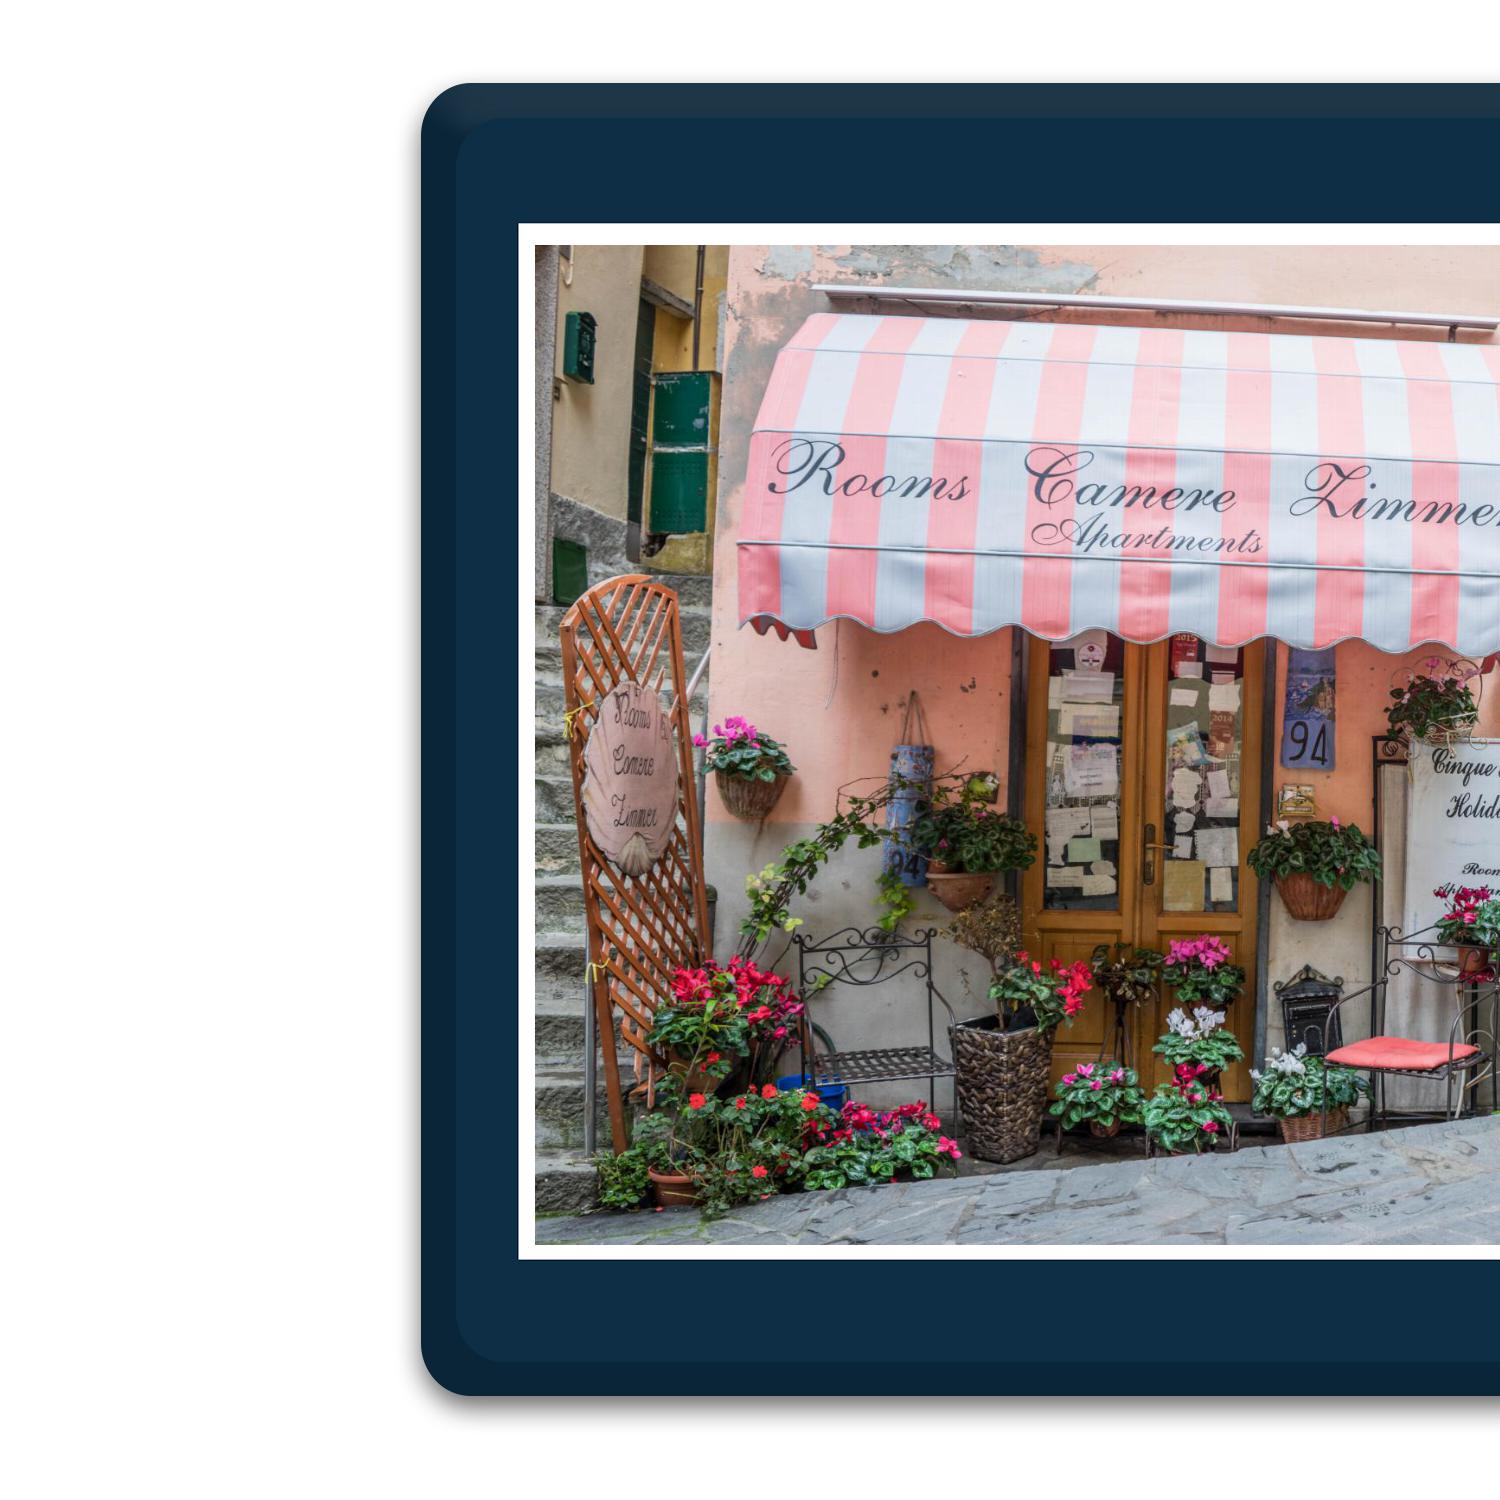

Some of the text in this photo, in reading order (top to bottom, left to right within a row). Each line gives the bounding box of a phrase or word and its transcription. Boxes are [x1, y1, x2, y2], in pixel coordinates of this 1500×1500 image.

[768, 438, 971, 500] Rooms
[1024, 447, 1237, 512] Camere
[1031, 512, 1264, 554] Apartments
[614, 690, 651, 729] Rooms
[1288, 720, 1329, 766] 94
[1431, 747, 1497, 787] Cinque
